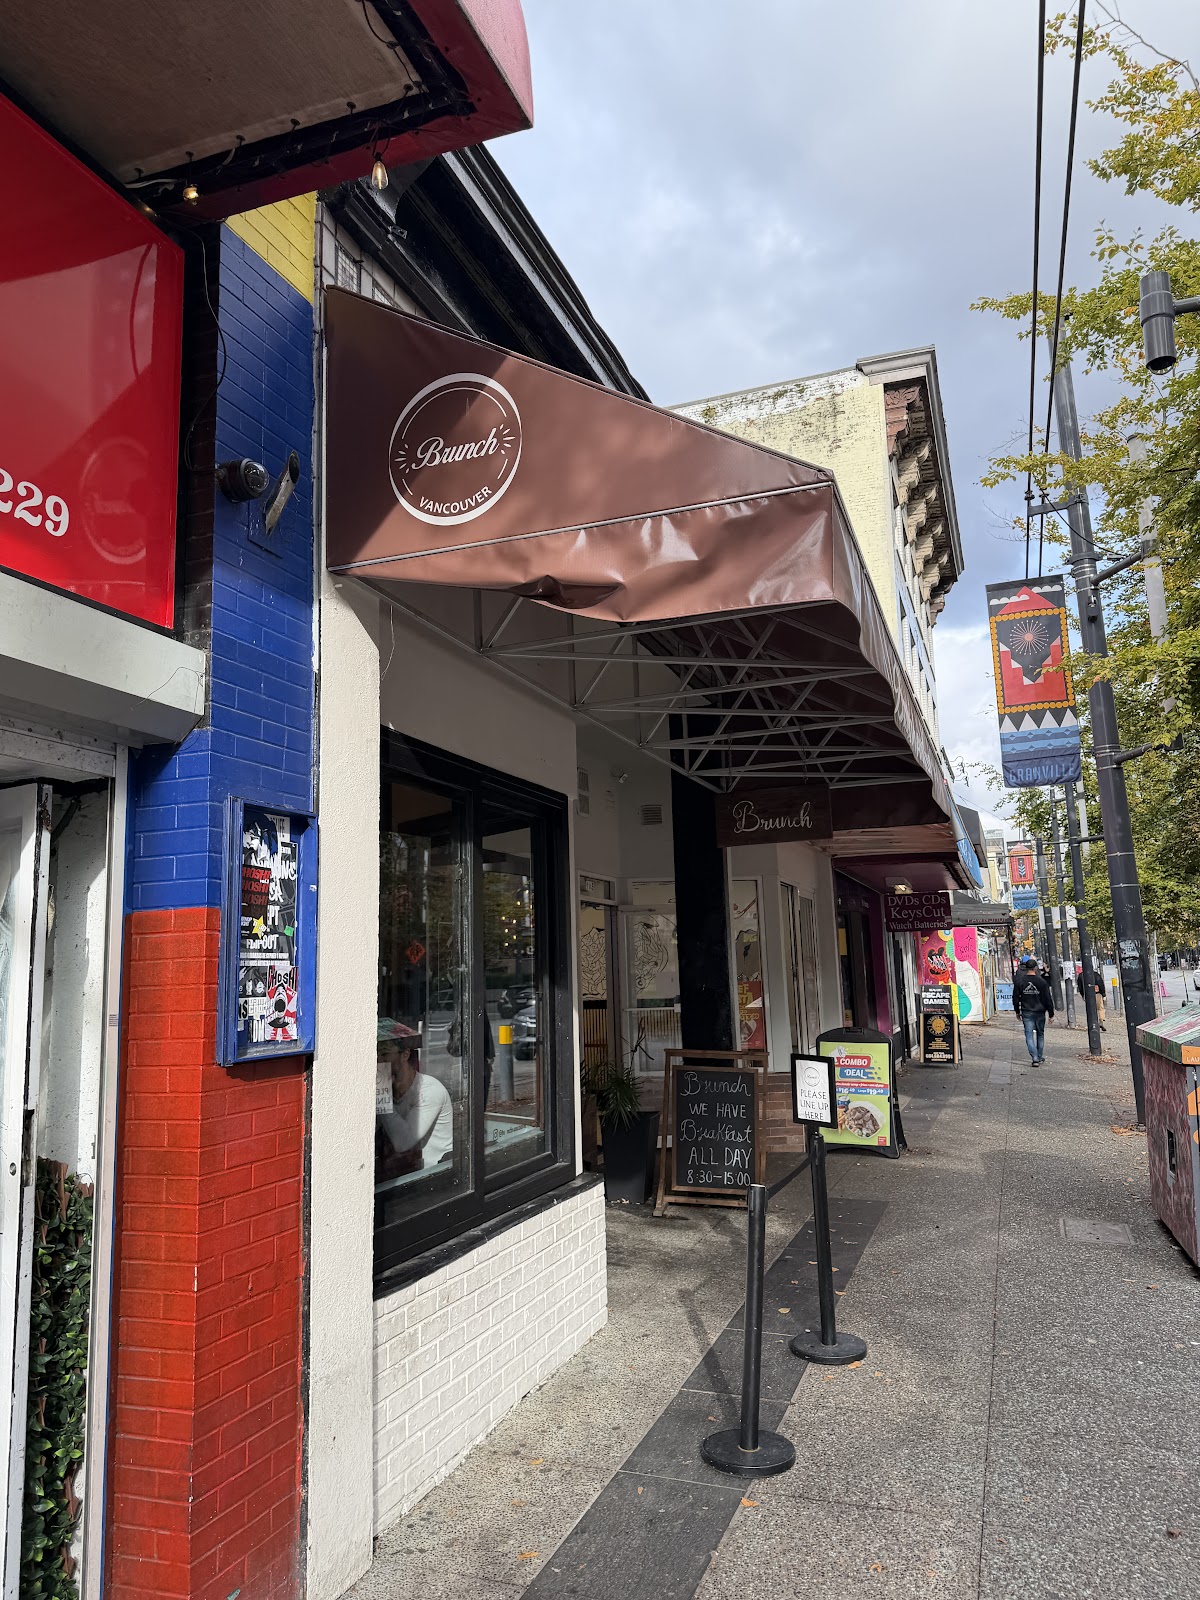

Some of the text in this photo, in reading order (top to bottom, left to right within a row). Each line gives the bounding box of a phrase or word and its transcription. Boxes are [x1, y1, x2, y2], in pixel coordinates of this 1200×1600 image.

[411, 427, 500, 470] Brunch
[419, 486, 493, 514] VANCOUVER
[1009, 763, 1075, 782] GRANVILLE
[732, 800, 813, 834] Brunch
[888, 894, 946, 906] DVDs CDs
[889, 920, 948, 930] Watch Batteries
[840, 1057, 868, 1066] COMBO
[844, 1069, 867, 1079] DEAL
[680, 1072, 751, 1097] Brunch
[800, 1088, 827, 1100] PLEASE
[689, 1103, 747, 1119] WE HAVE
[800, 1099, 829, 1111] LINE UP
[804, 1110, 824, 1121] HERE
[680, 1119, 752, 1143] Breakfast
[688, 1146, 753, 1169] ALL DAY
